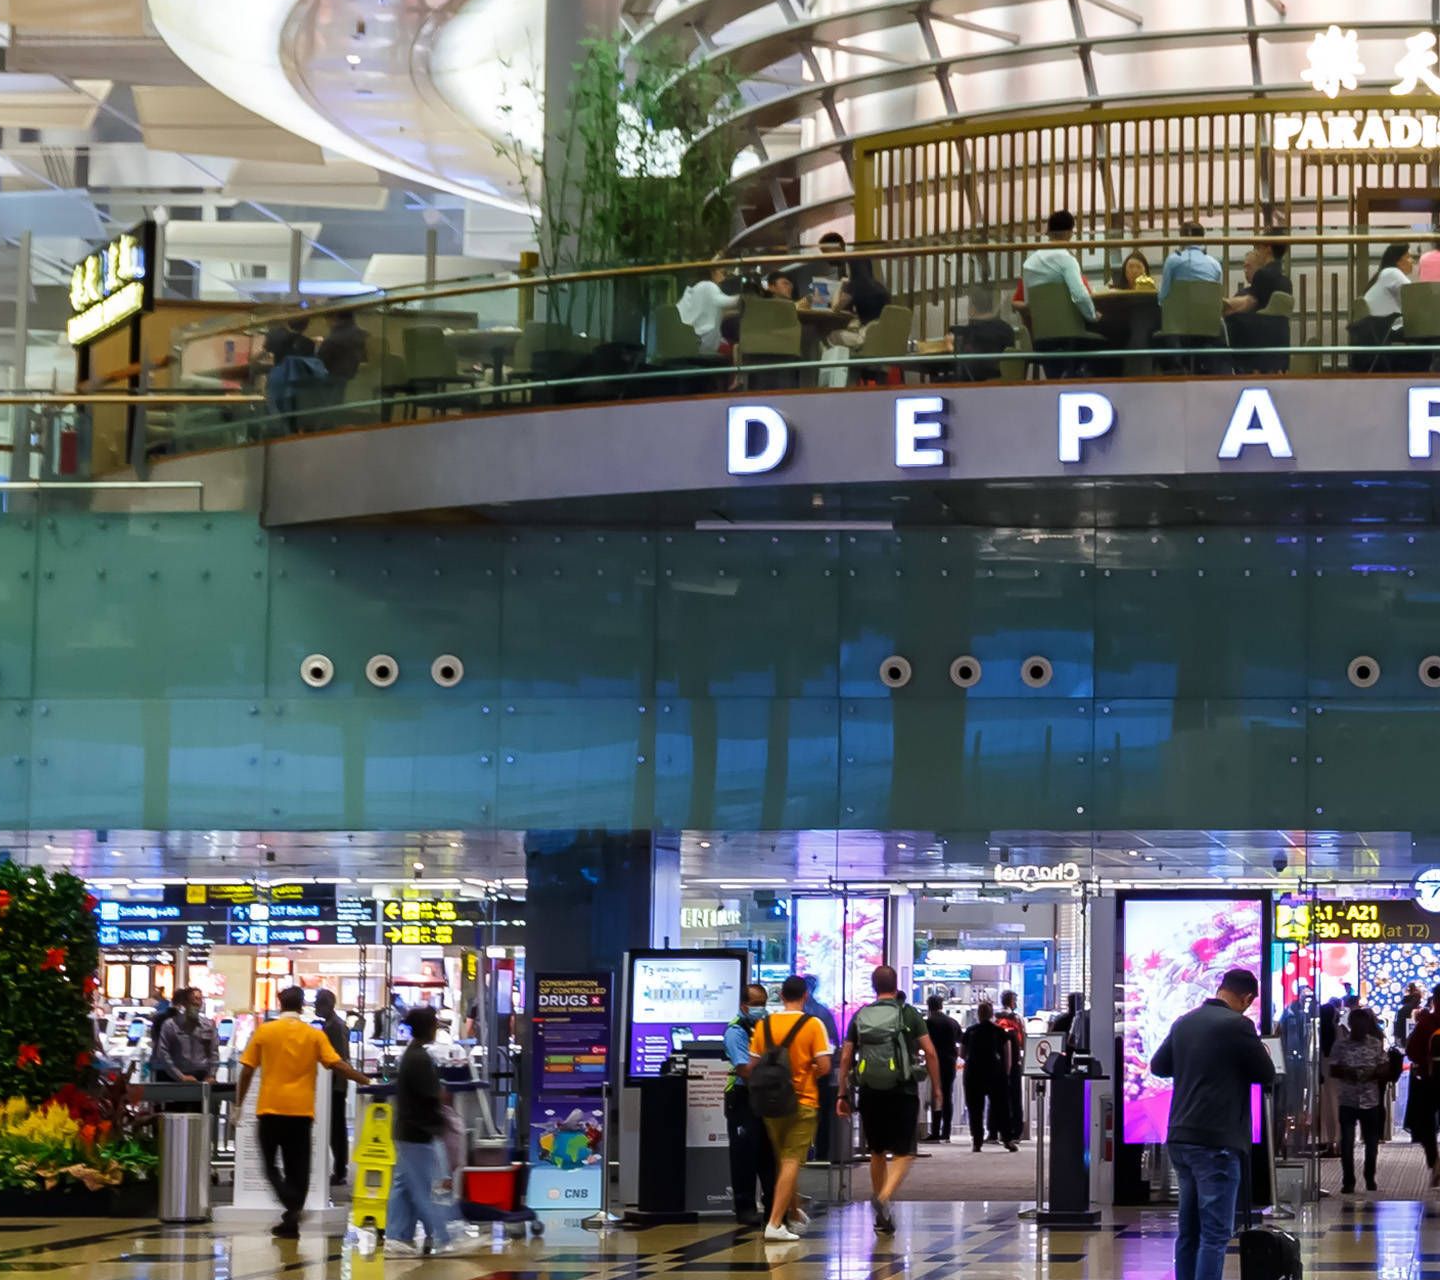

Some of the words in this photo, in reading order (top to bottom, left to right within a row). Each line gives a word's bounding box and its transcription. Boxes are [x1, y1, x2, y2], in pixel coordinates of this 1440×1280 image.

[1346, 905, 1378, 920] A21
[1352, 922, 1380, 938] F60
[1382, 924, 1402, 939] (at
[1407, 924, 1430, 939] T2)
[553, 987, 607, 995] CONTROLLED
[539, 995, 588, 1007] DRUGS
